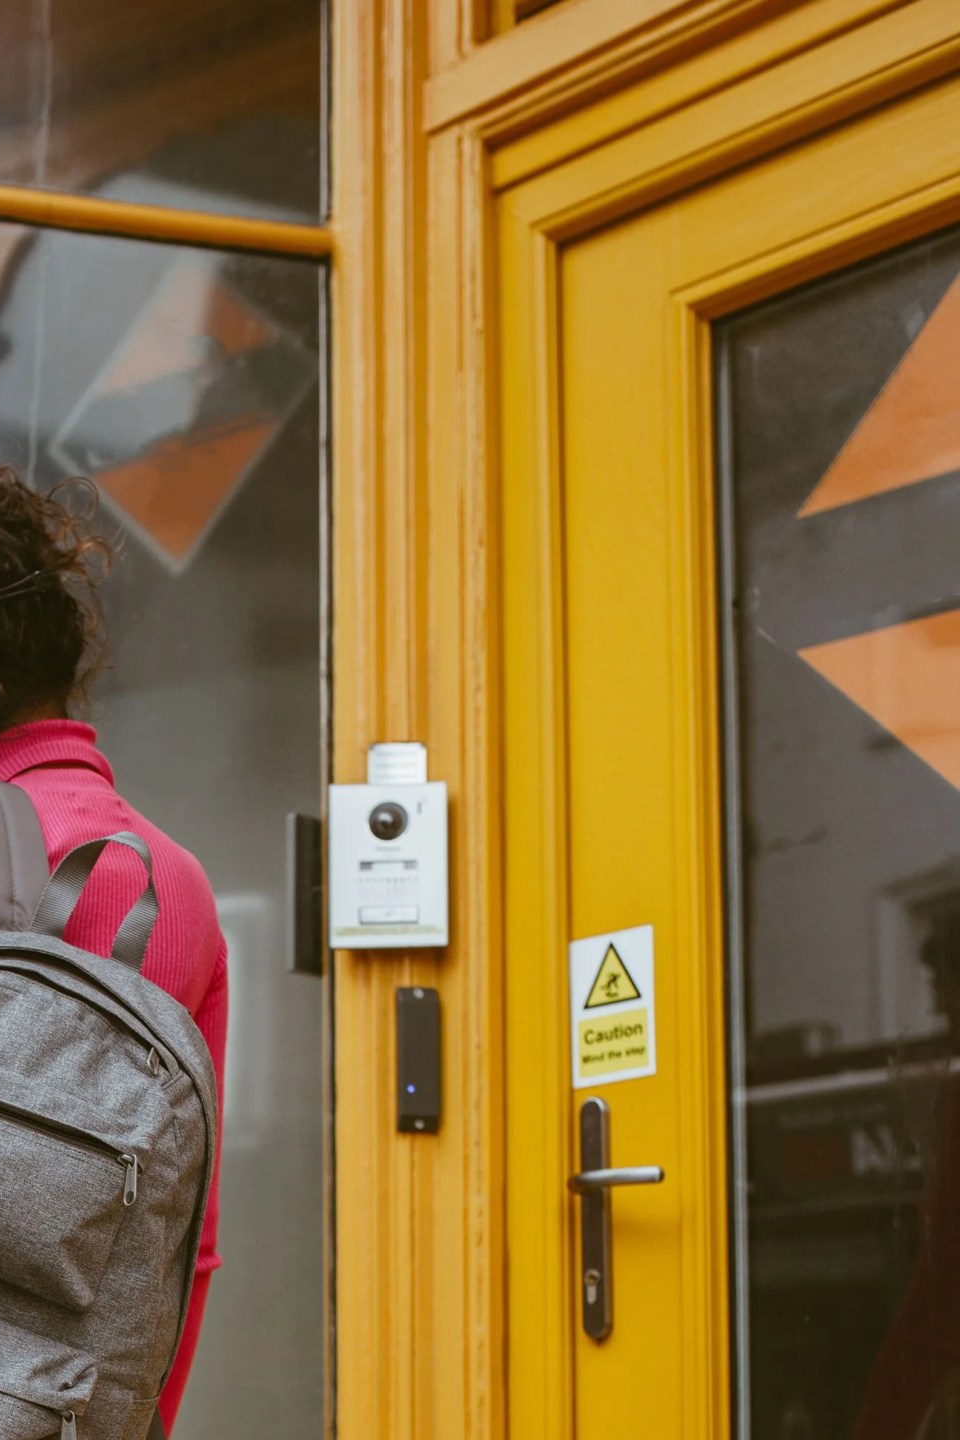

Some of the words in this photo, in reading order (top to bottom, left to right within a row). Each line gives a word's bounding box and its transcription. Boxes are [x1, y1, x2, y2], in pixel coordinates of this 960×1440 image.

[584, 1024, 643, 1045] Caution
[582, 1053, 604, 1064] Mind
[607, 1050, 621, 1060] the
[625, 1046, 646, 1057] step
